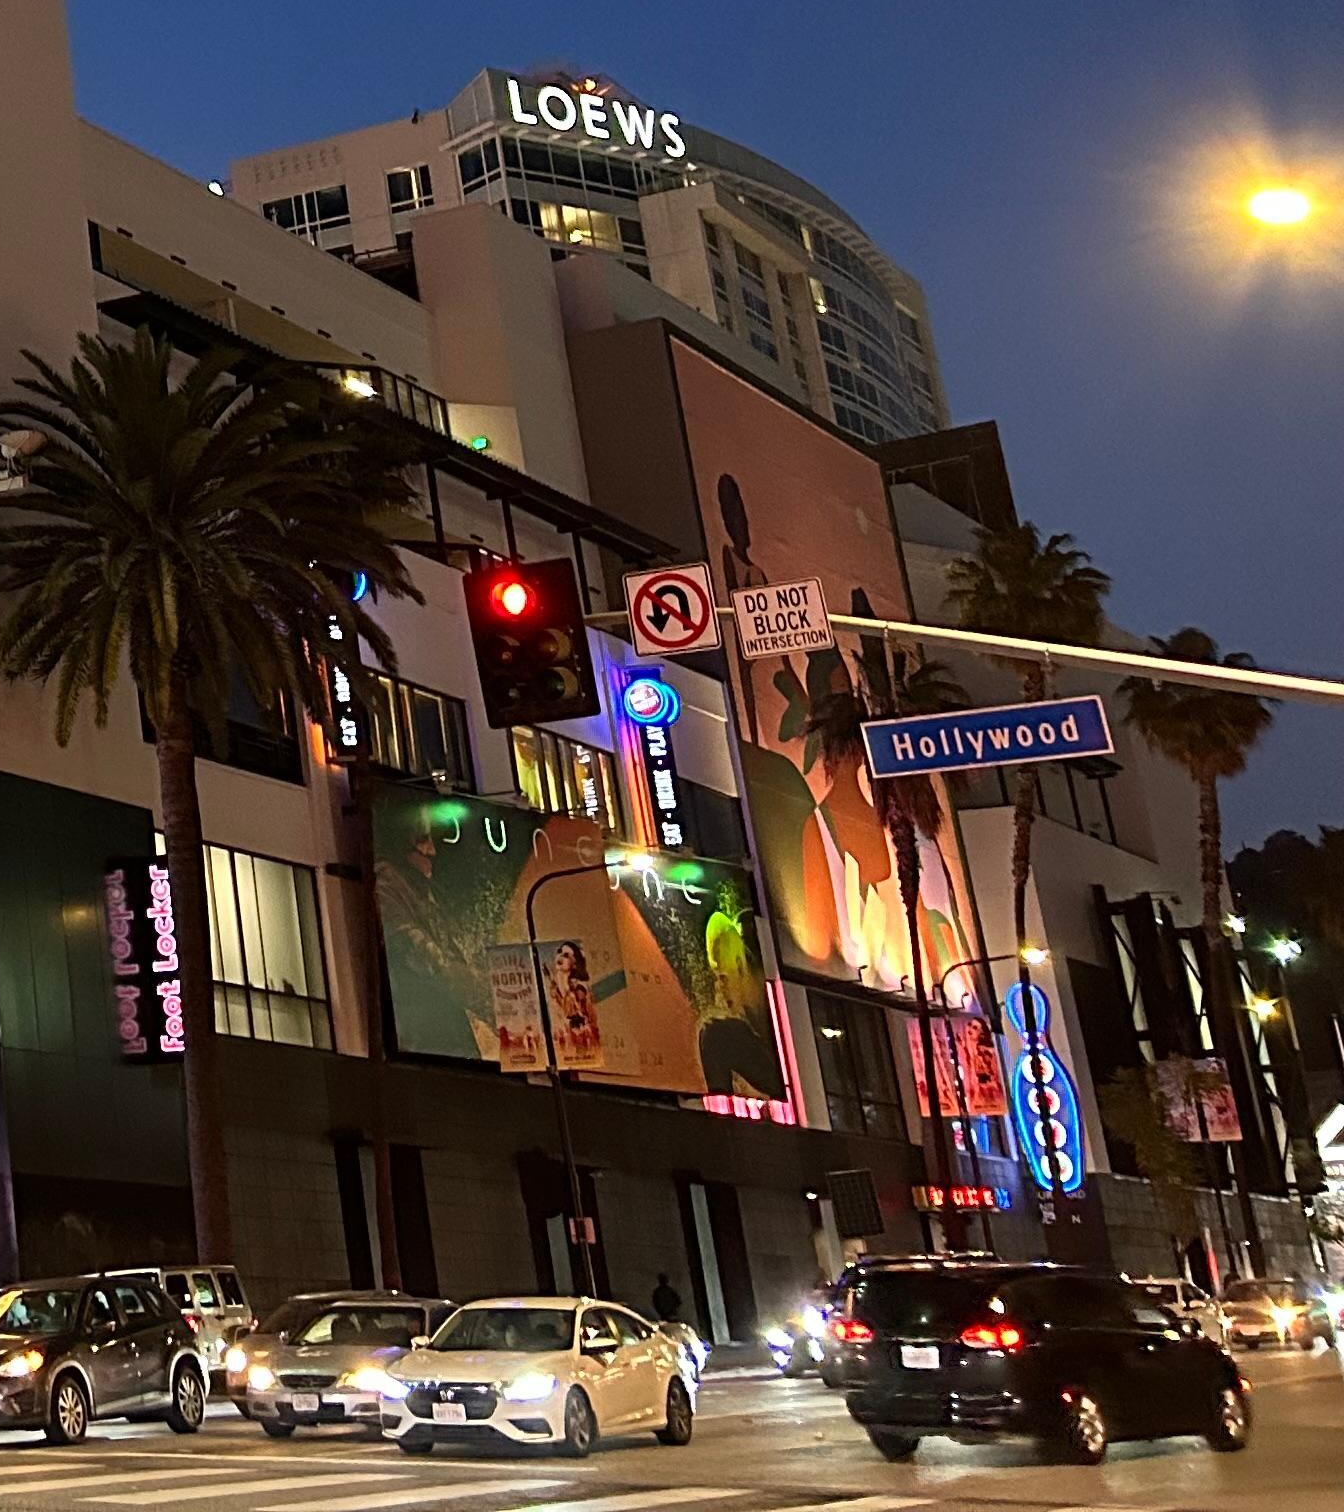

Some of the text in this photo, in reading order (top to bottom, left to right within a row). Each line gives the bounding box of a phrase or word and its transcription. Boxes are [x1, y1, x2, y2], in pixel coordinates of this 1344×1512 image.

[506, 77, 687, 159] LOEWS
[744, 586, 809, 614] DO NOT
[754, 609, 811, 636] BLOCK
[746, 629, 828, 654] INTERSECTION
[892, 714, 1080, 761] Hollywood
[146, 863, 186, 1052] Foot Locker
[492, 972, 533, 986] NORTH
